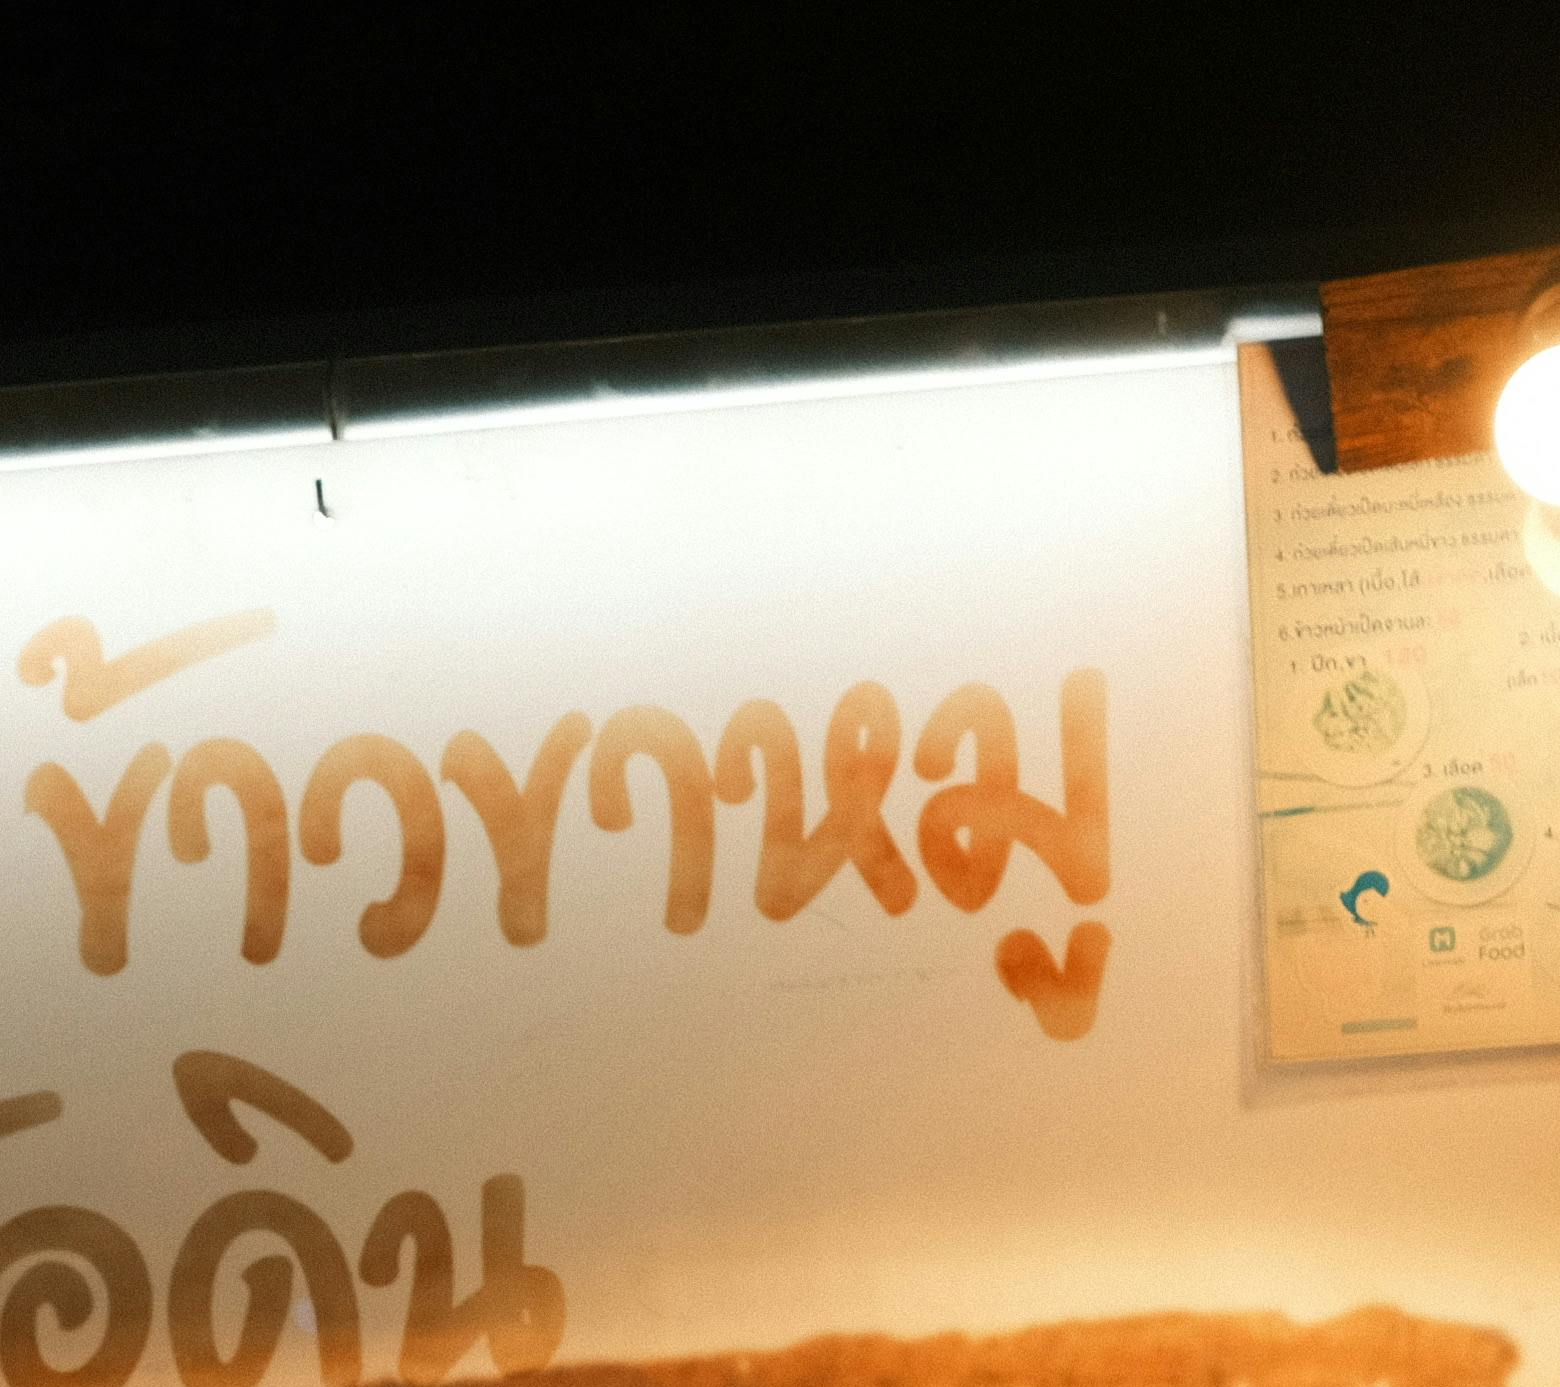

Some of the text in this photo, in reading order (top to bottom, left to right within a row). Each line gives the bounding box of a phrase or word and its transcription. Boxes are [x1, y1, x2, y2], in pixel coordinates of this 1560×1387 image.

[16, 605, 1114, 1041] ข้าวขาหมู
[1477, 942, 1527, 962] Food
